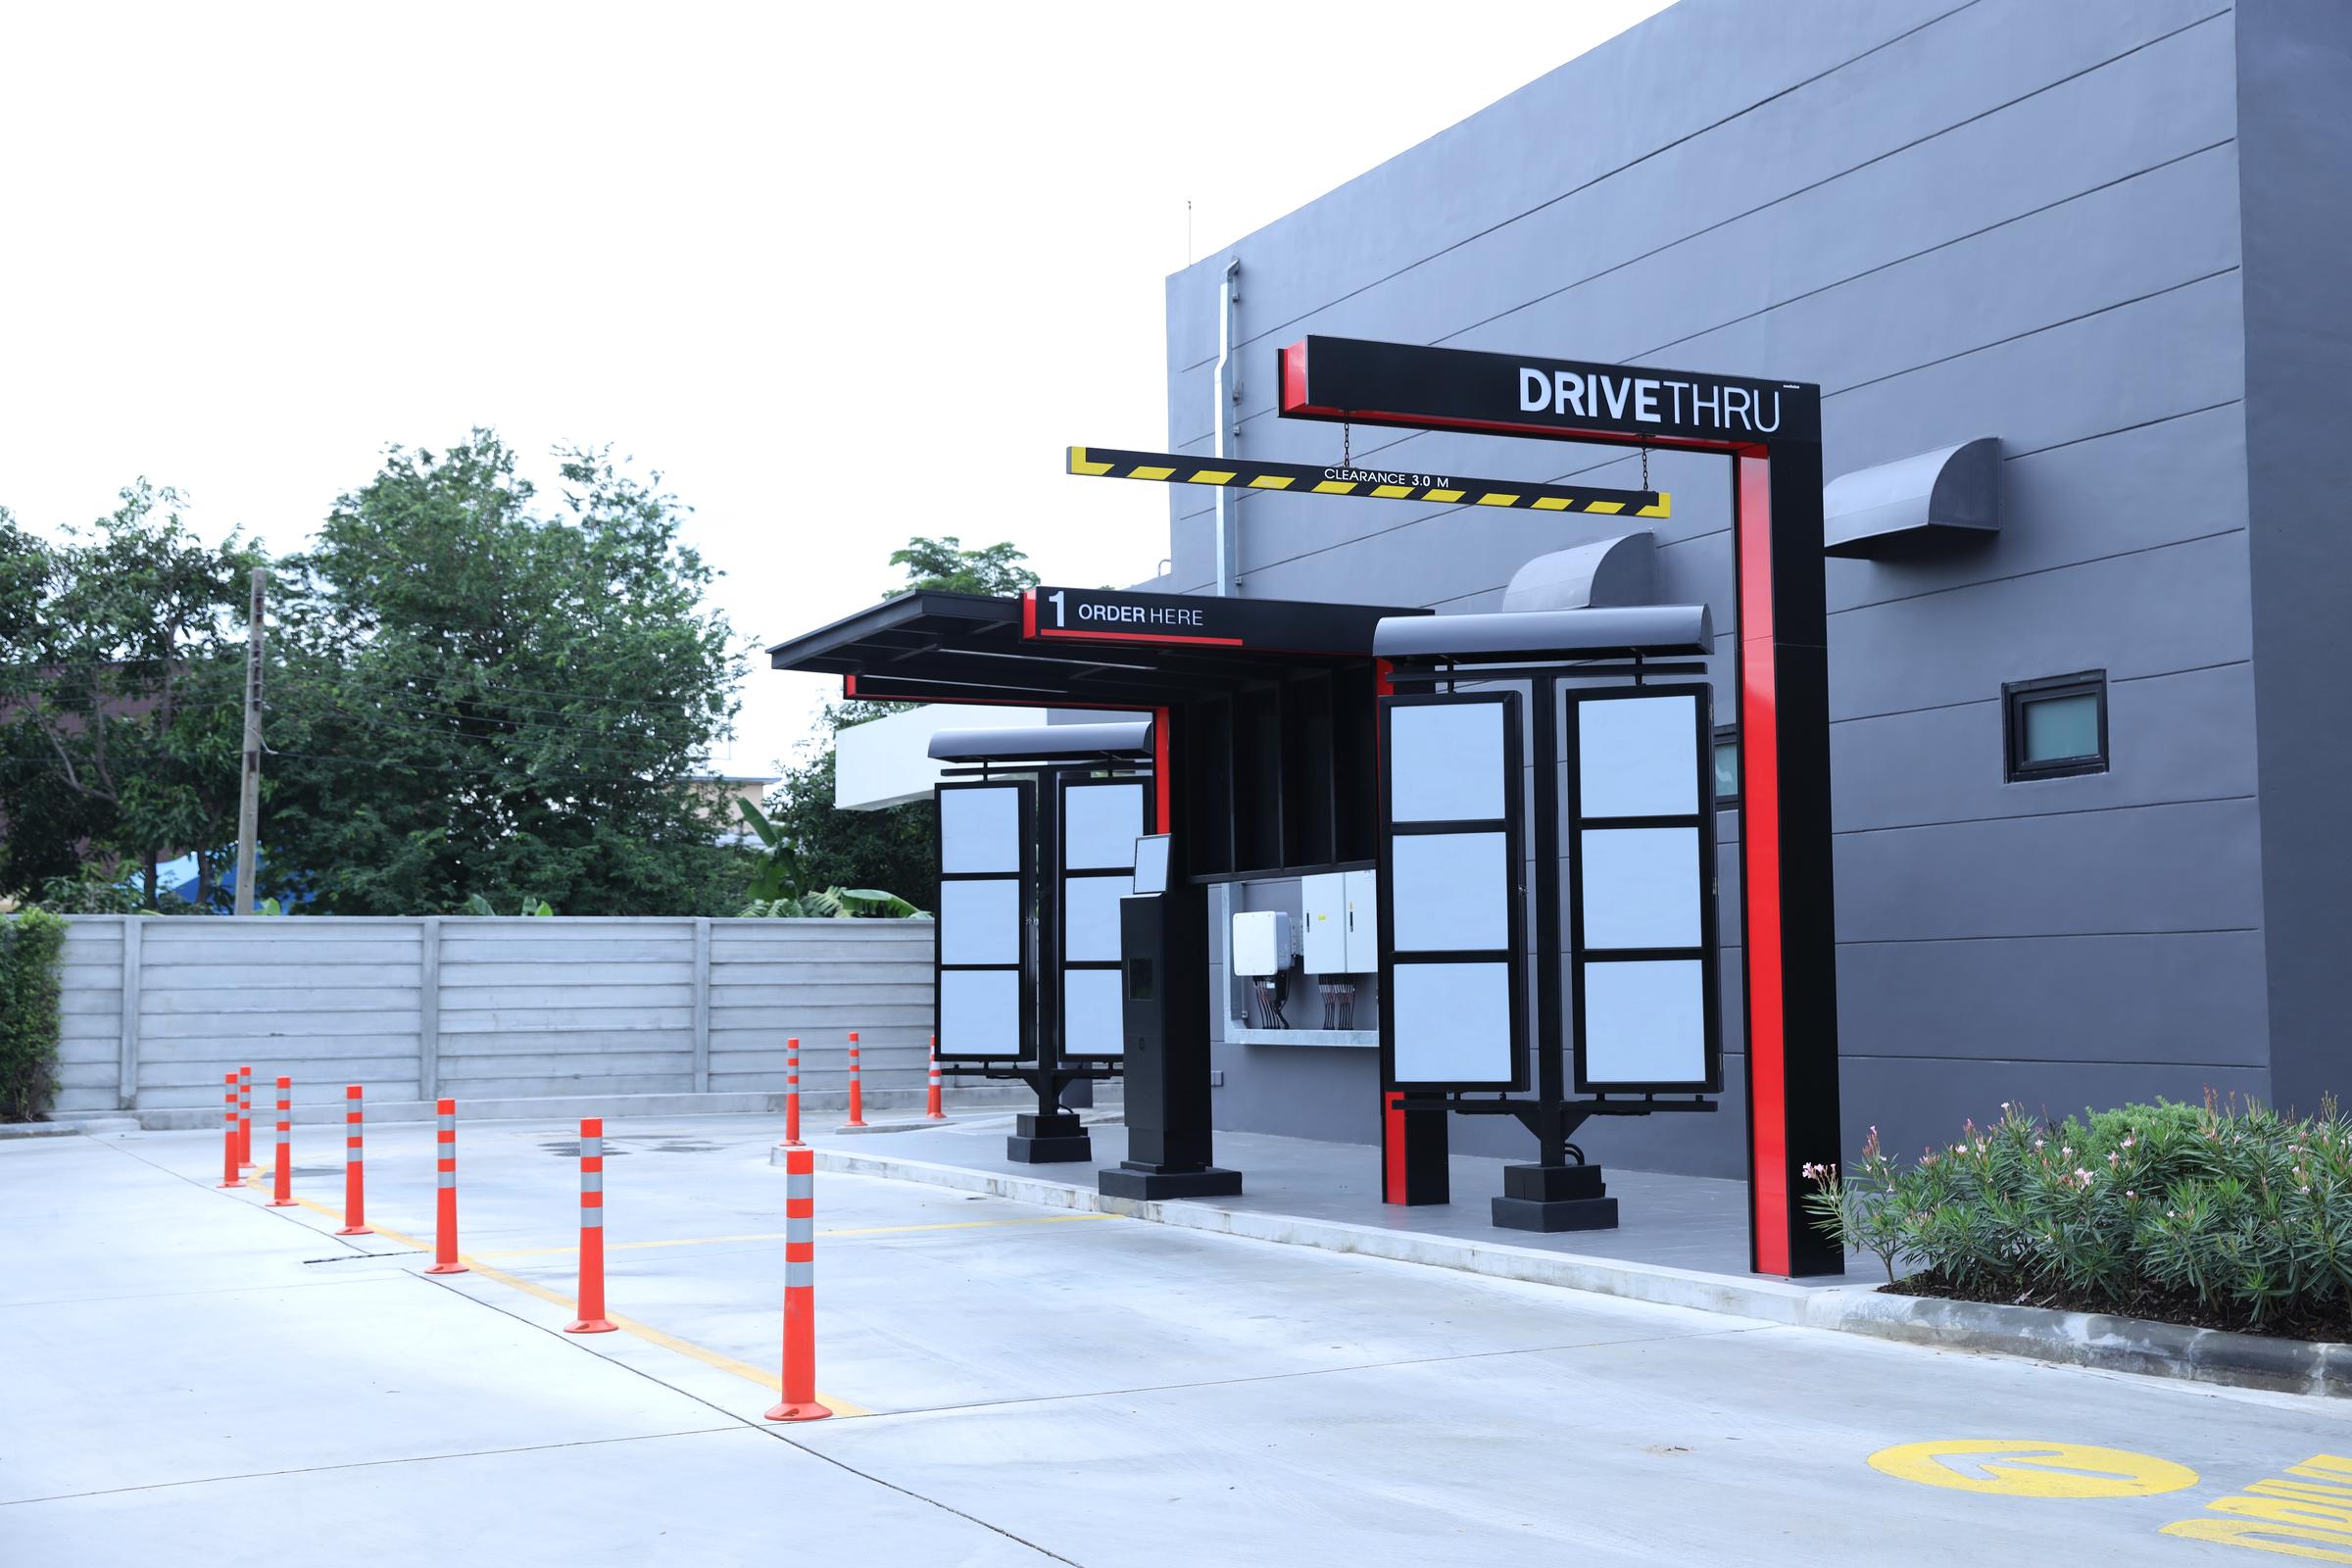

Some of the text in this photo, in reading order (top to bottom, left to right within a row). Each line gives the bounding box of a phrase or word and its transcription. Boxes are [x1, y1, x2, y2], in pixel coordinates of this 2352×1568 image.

[1519, 368, 1780, 433] DRIVETHRU
[1324, 468, 1449, 488] CLEARANCE 3.0 M
[1048, 590, 1203, 627] 1 ORDER HERE
